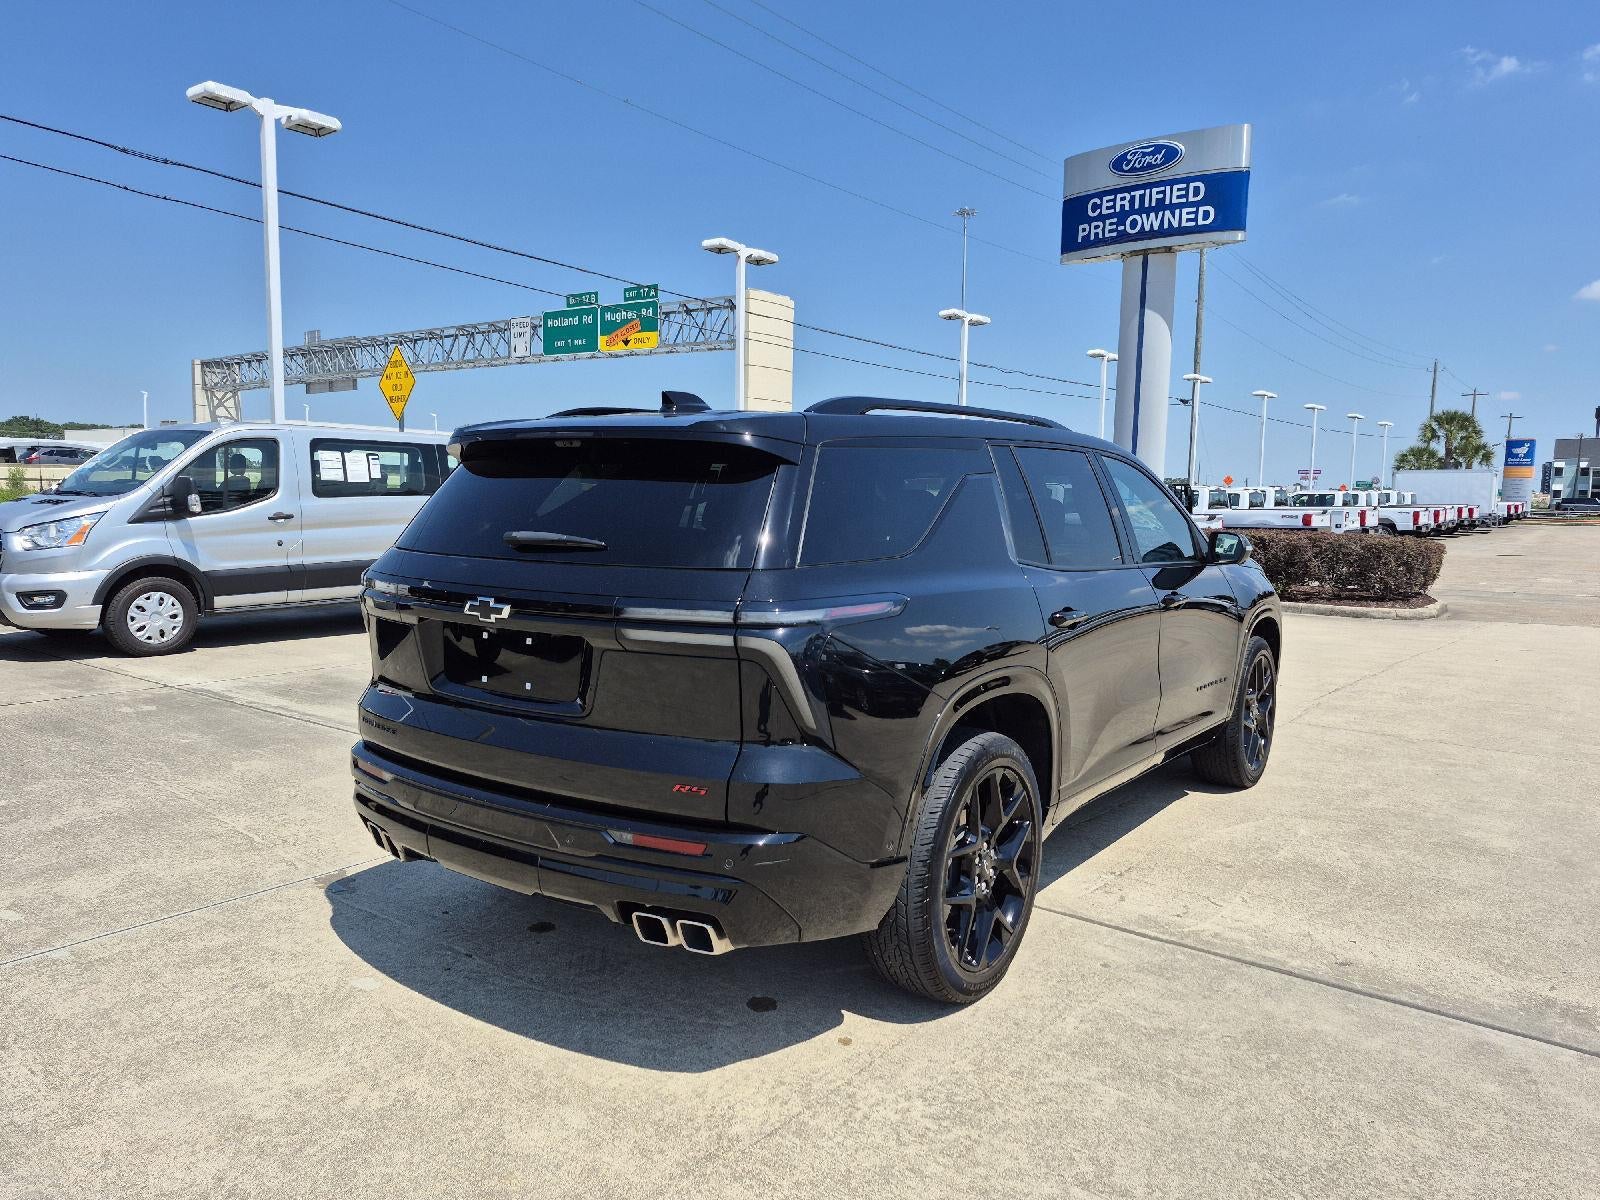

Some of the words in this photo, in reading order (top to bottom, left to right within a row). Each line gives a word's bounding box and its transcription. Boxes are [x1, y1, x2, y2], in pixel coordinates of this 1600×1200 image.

[1123, 146, 1167, 170] Ford
[1087, 181, 1206, 217] CERTIFIED
[1077, 205, 1215, 243] PRE-OWNED
[625, 290, 638, 298] EXIT
[640, 288, 648, 297] 17
[547, 315, 579, 328] Holland
[582, 313, 593, 325] Rd
[604, 310, 637, 323] Hughes
[641, 307, 653, 318] Rd
[513, 331, 527, 339] LIMIT
[633, 336, 651, 345] ONLY
[554, 340, 565, 348] EXIT
[672, 784, 709, 796] RS
